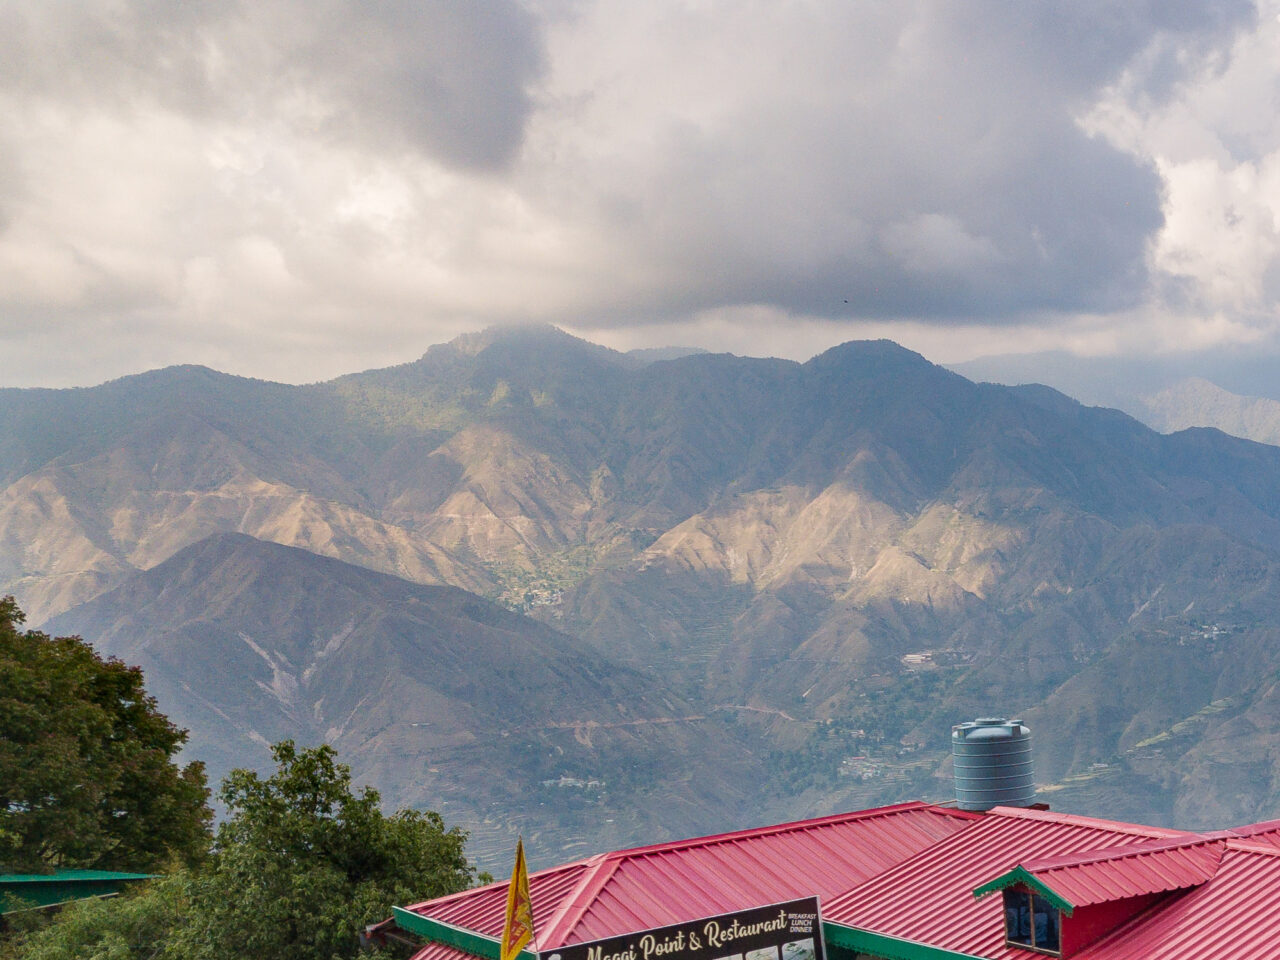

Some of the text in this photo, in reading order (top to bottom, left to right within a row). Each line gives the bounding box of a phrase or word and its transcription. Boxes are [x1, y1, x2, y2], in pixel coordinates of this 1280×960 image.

[639, 930, 686, 960] Point
[689, 931, 703, 951] &
[704, 909, 788, 947] Restaurant
